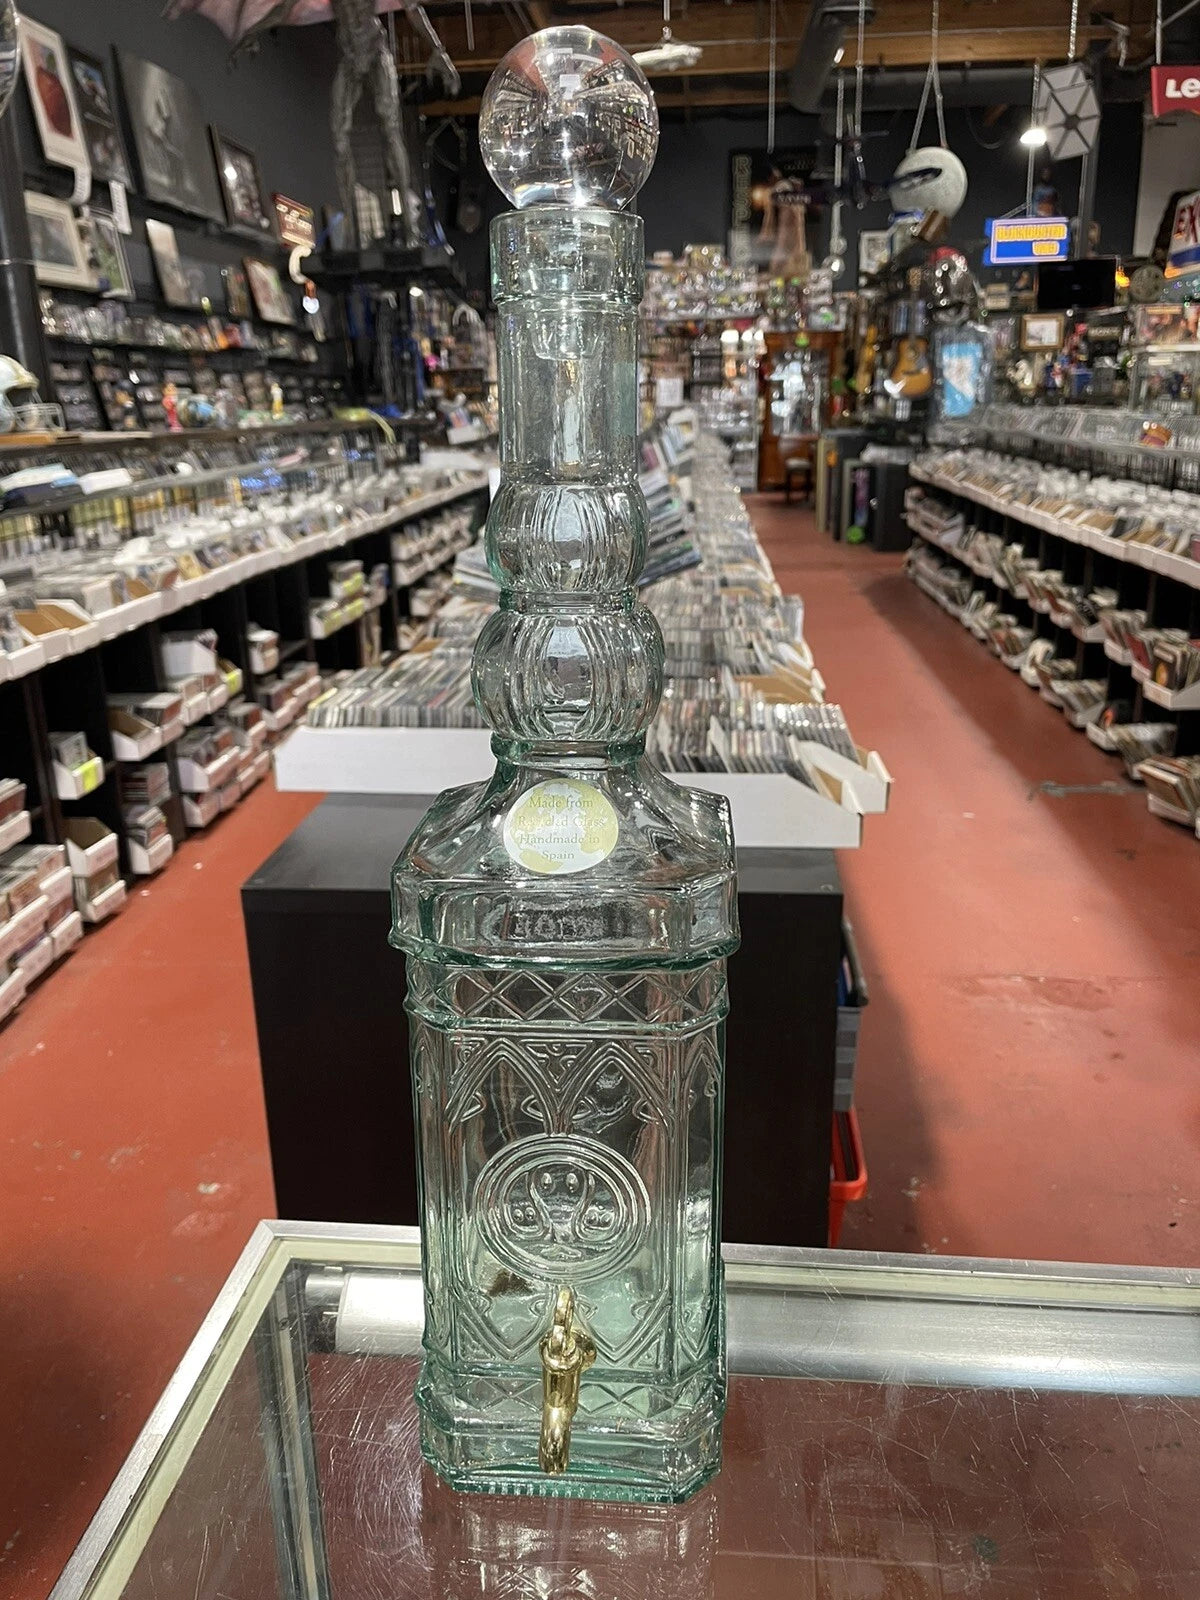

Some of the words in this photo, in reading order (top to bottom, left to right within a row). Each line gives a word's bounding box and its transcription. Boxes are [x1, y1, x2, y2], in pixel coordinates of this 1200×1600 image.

[529, 795, 562, 808] Made
[566, 795, 593, 809] from
[518, 815, 568, 828] Recled
[573, 815, 606, 827] Glass
[519, 833, 585, 844] Handmade
[588, 835, 600, 844] in
[541, 851, 575, 861] Spain
